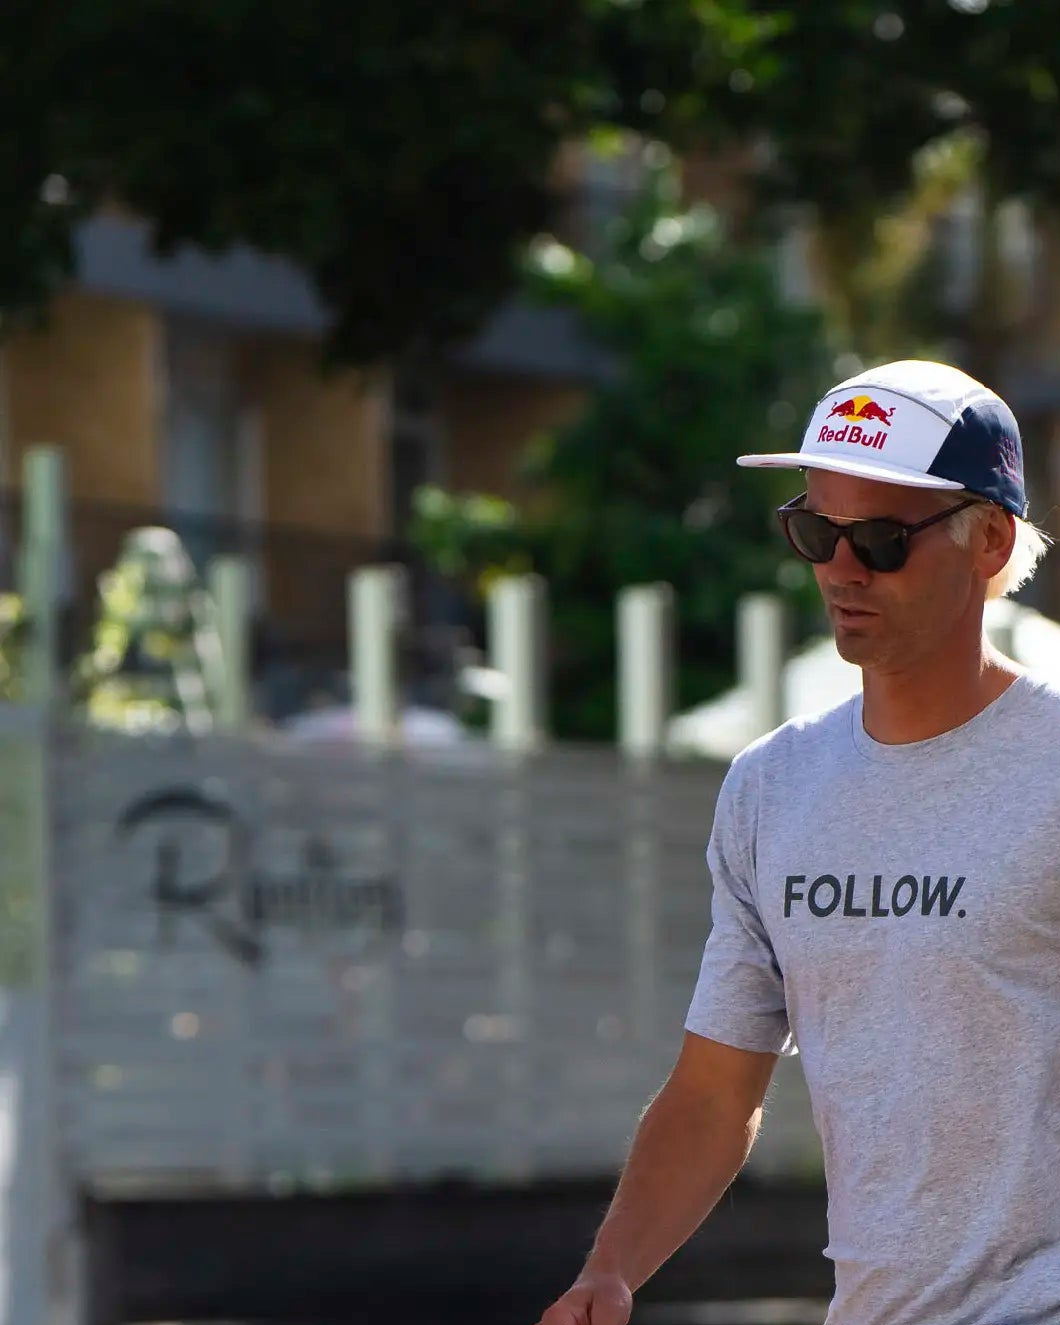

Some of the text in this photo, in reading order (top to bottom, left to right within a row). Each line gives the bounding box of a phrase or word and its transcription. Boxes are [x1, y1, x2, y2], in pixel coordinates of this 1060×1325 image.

[817, 424, 888, 450] Red Bull
[783, 874, 967, 919] FOLLOW.
